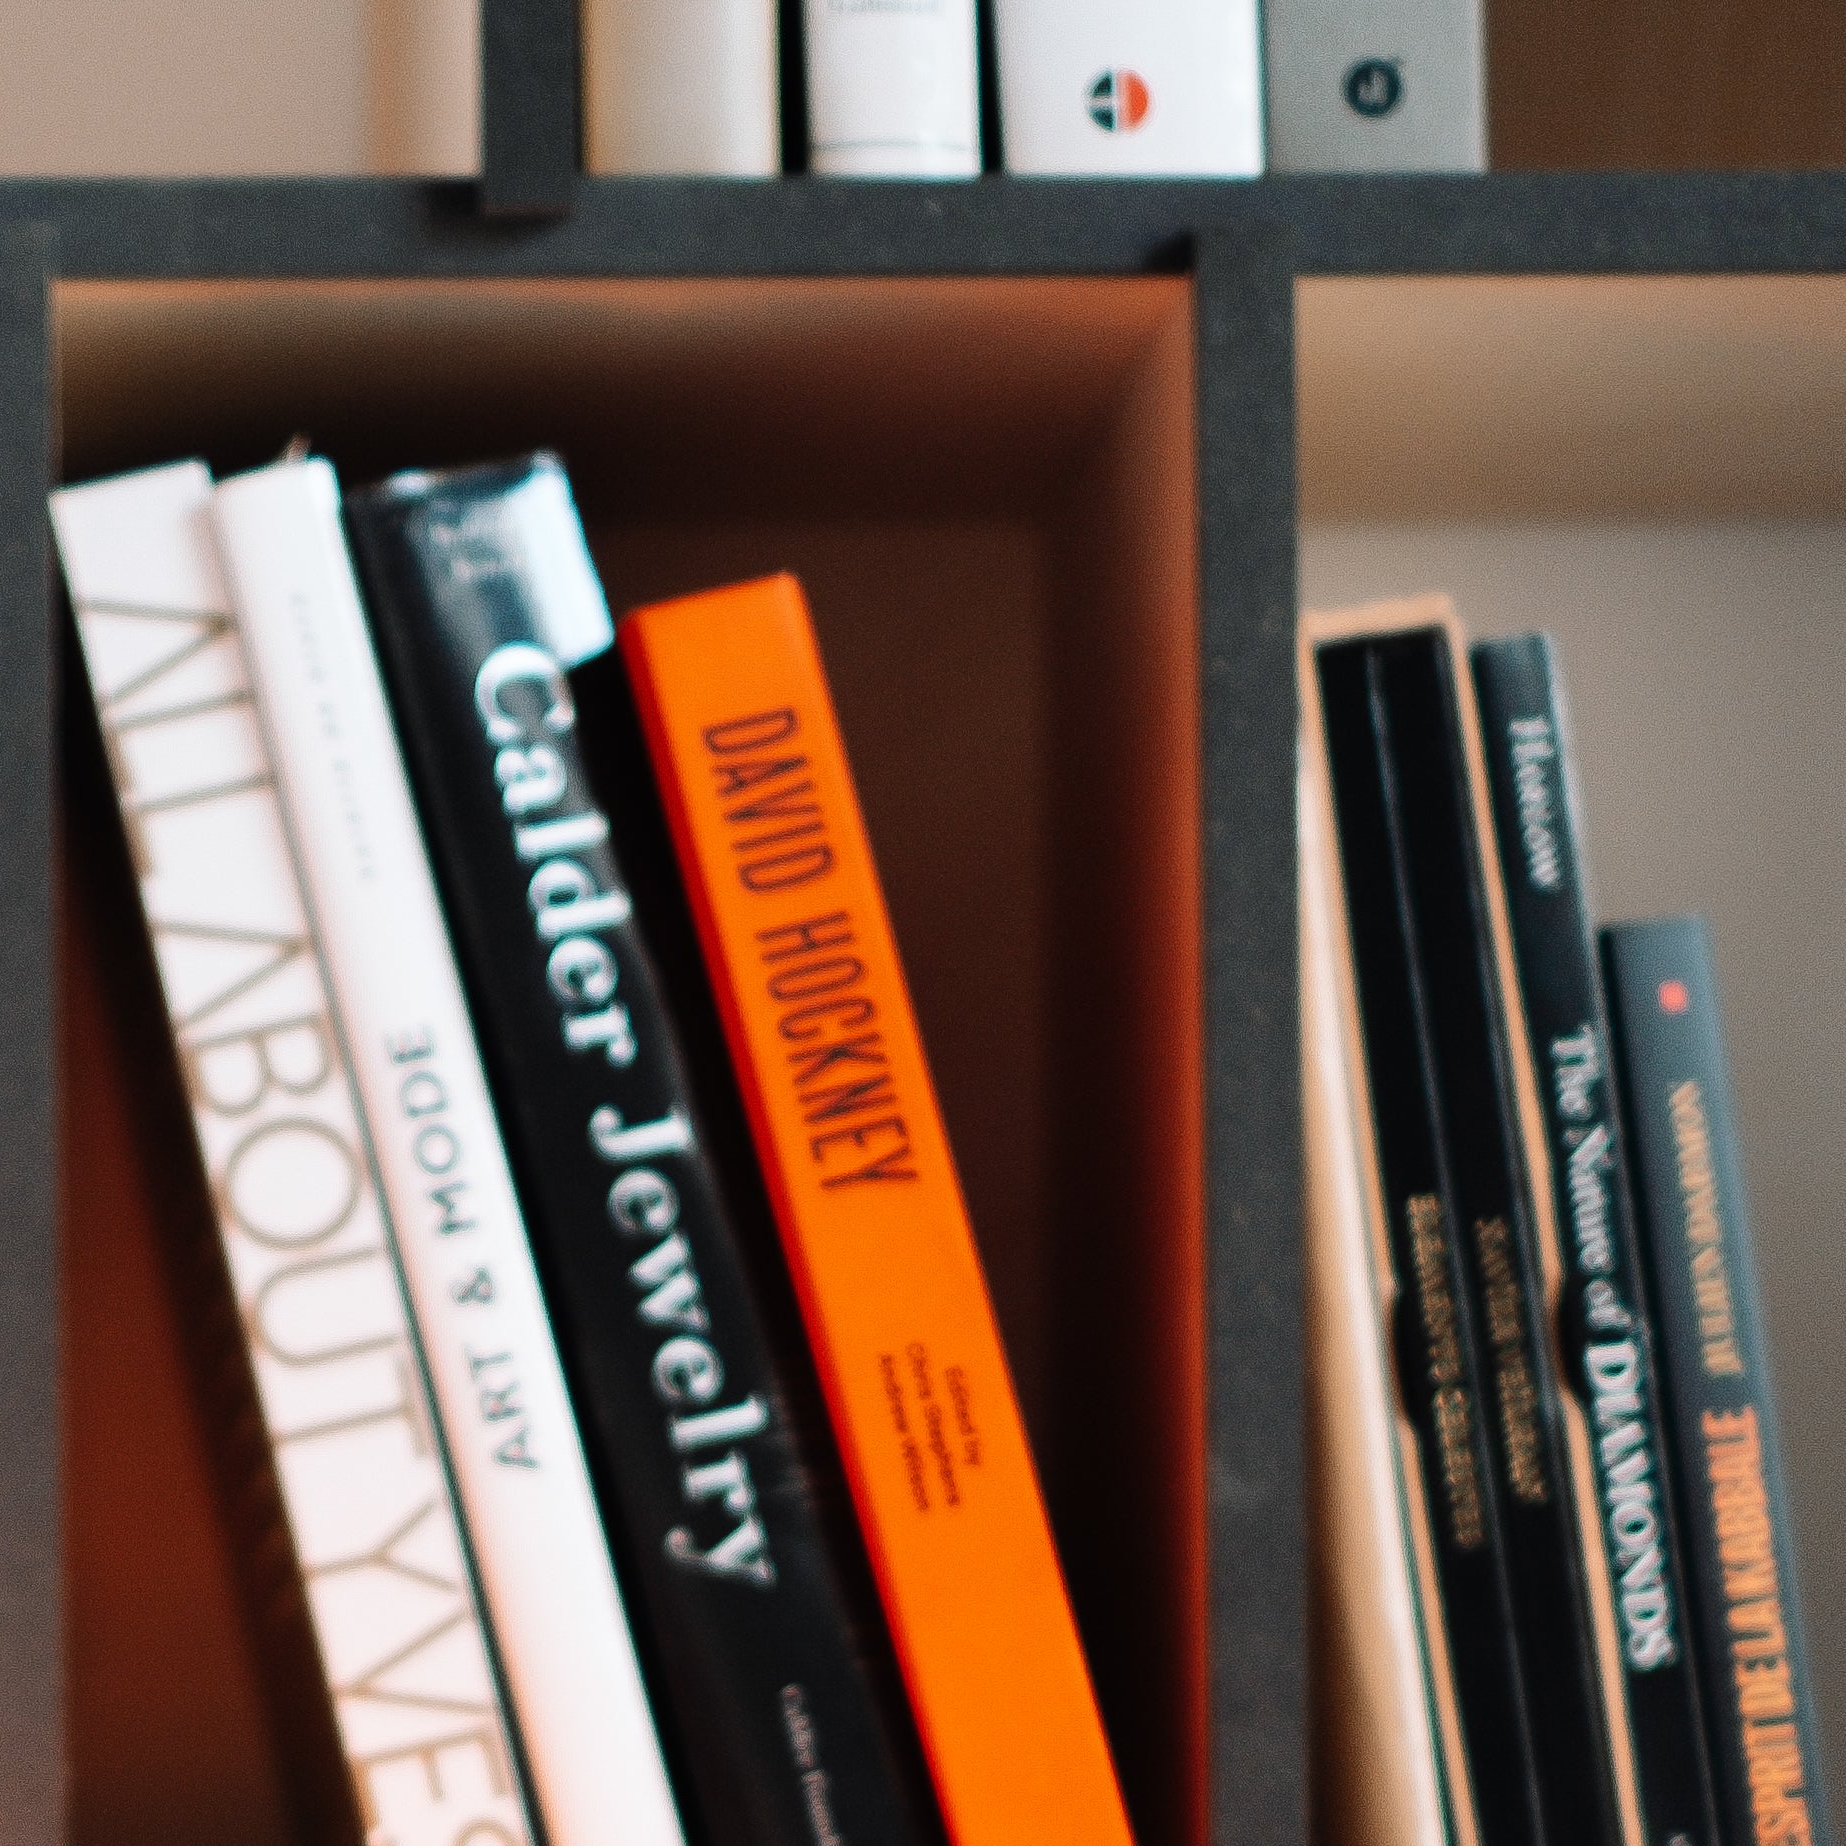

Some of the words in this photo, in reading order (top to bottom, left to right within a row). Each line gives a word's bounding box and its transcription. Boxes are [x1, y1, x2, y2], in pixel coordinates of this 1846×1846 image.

[703, 707, 835, 893] DAVID
[384, 1024, 480, 1236] MODE
[475, 640, 638, 1067] Calder
[589, 1102, 774, 1588] Jewelry
[755, 911, 918, 1191] HOCKNEY
[451, 1267, 498, 1306] &
[1554, 1025, 1601, 1119] The
[1584, 1340, 1676, 1673] DIAMONDS
[466, 1345, 540, 1472] ART
